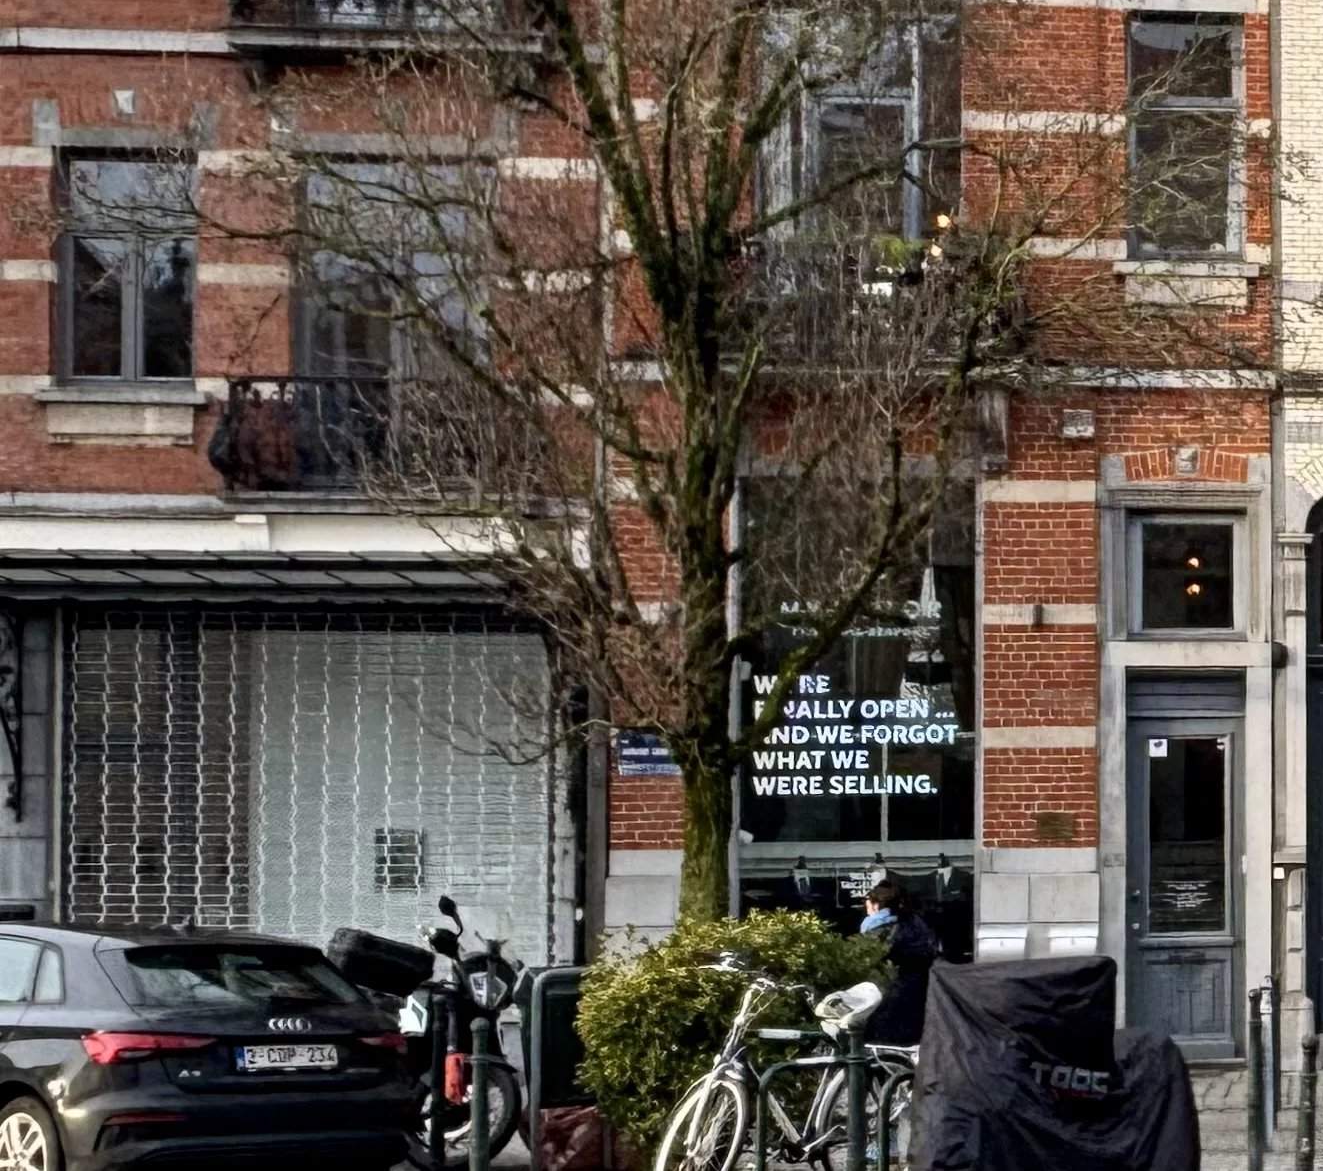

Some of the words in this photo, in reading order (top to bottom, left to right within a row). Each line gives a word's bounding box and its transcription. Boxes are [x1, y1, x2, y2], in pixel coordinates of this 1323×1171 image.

[753, 675, 830, 694] WRE
[860, 699, 929, 719] OPEN
[763, 726, 808, 745] ND
[816, 726, 854, 744] WE
[861, 724, 959, 745] FORGOT
[753, 751, 825, 770] WHAT
[831, 750, 870, 769] WE
[753, 776, 824, 796] WERE
[829, 775, 938, 795] SELLING.
